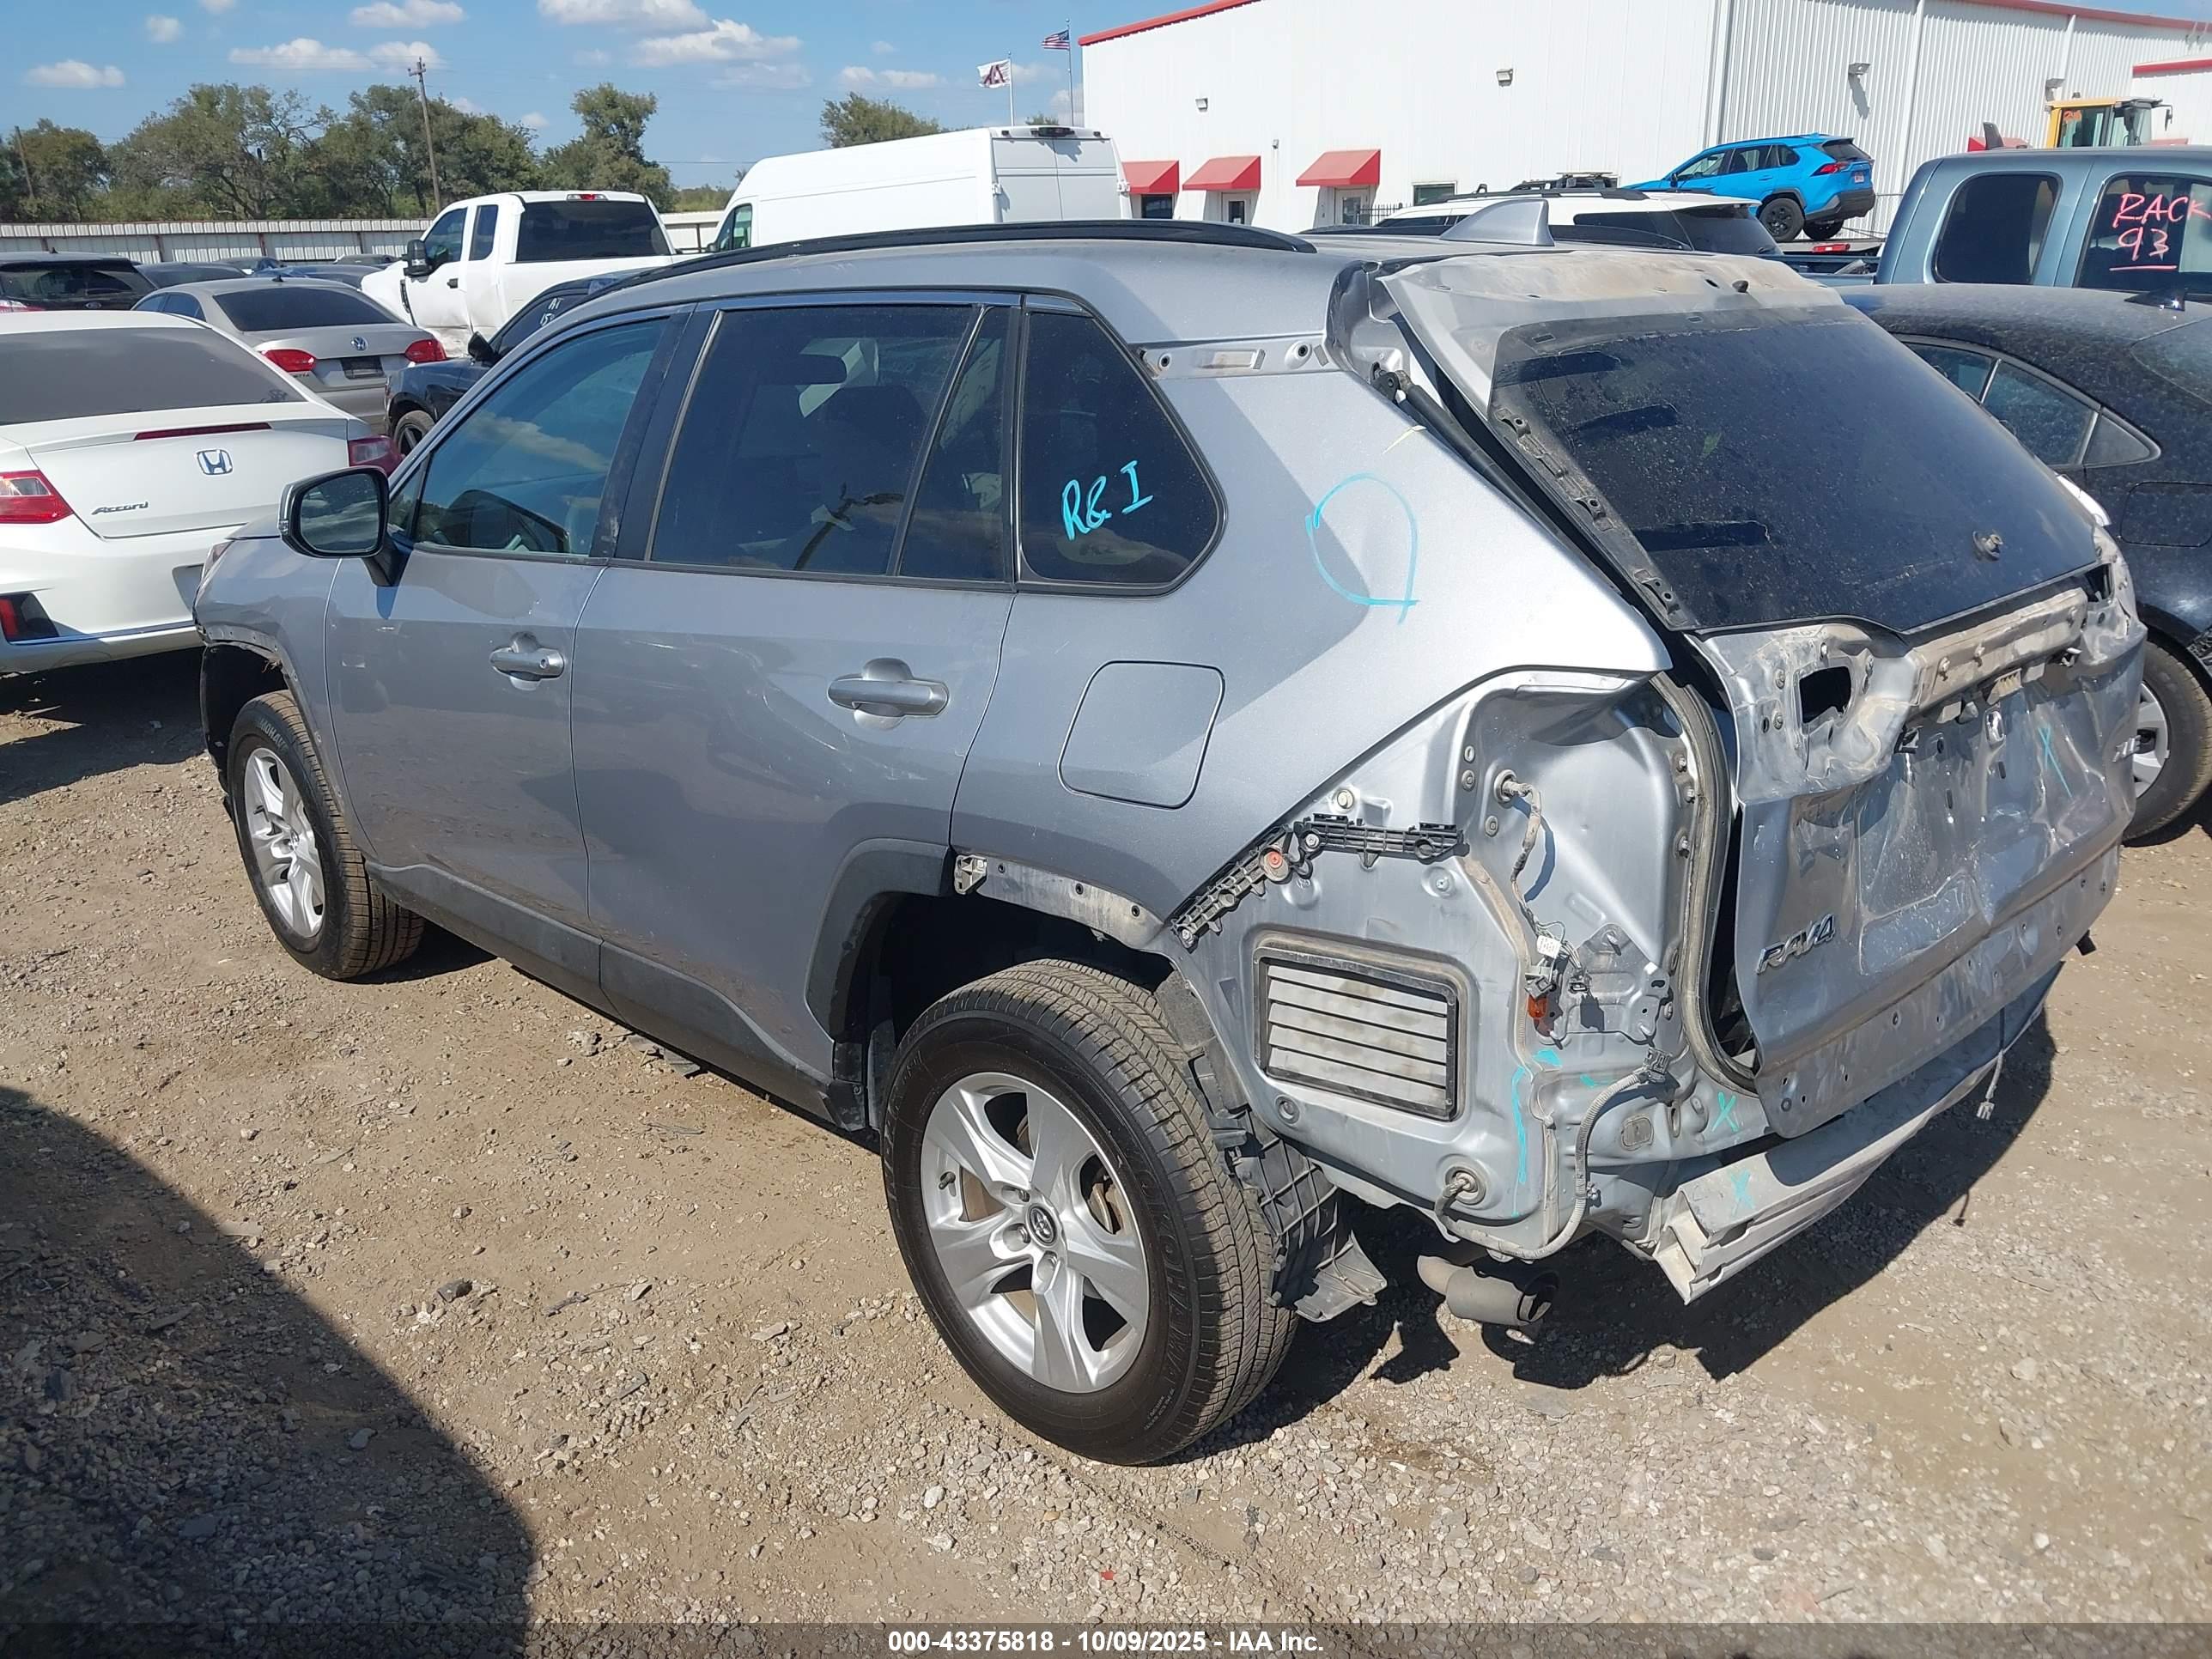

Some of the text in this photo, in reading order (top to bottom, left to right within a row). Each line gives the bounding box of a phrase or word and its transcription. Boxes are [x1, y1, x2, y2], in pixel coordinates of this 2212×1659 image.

[2112, 193, 2212, 228] RACK
[2118, 227, 2170, 261] 93
[91, 501, 149, 515] Accord
[1756, 914, 1835, 974] RAV4
